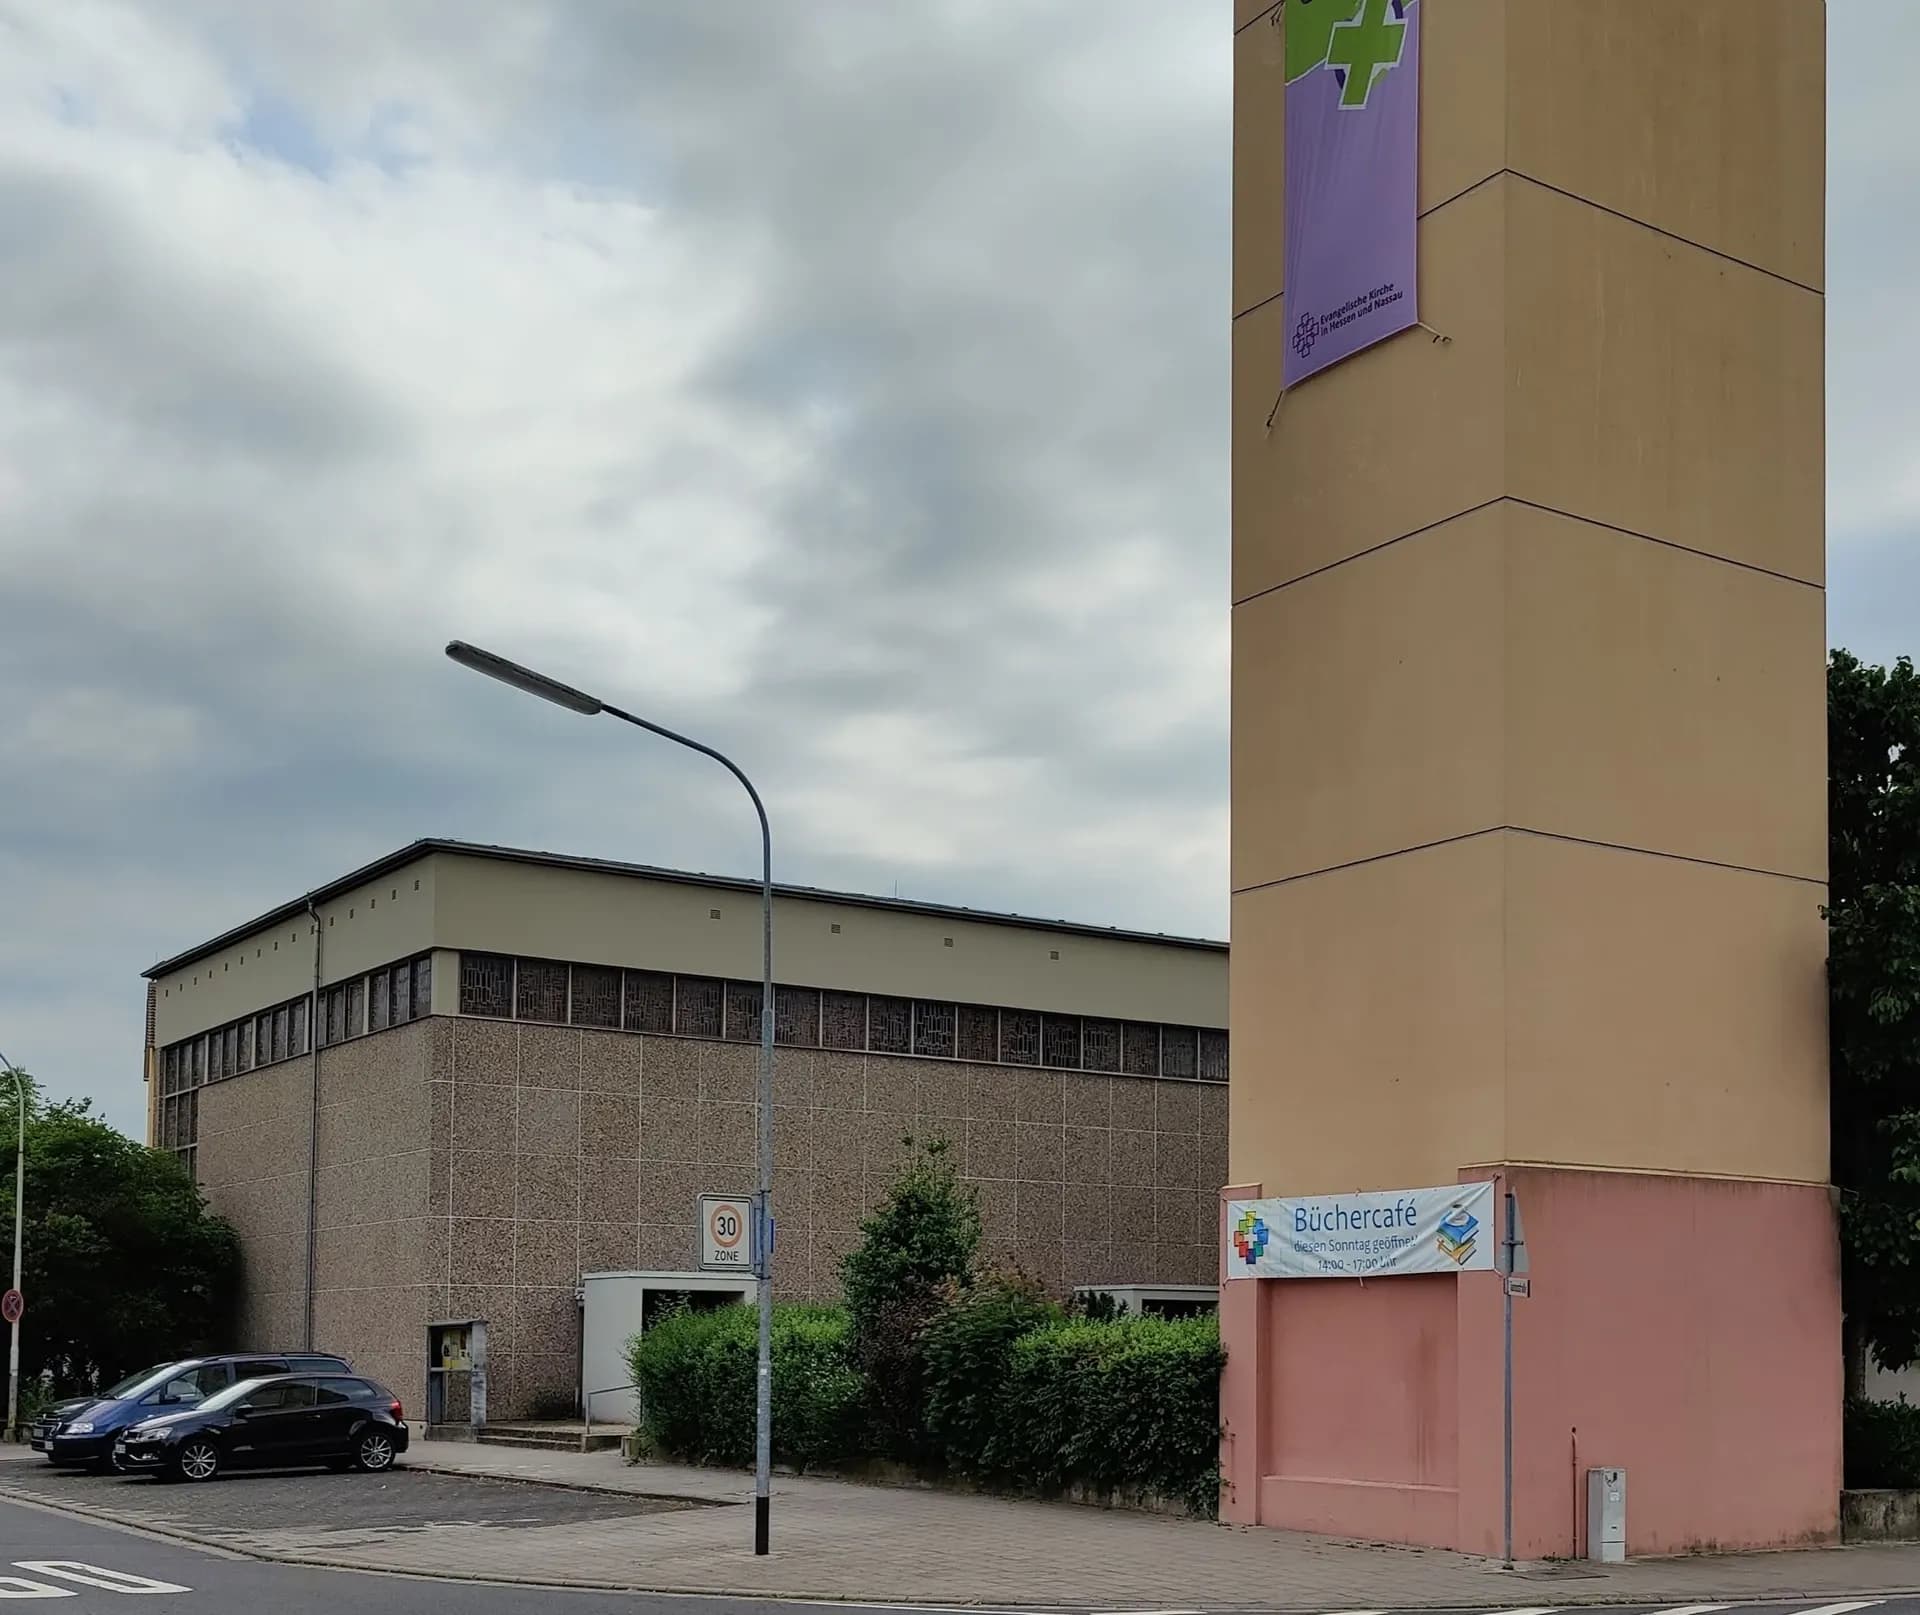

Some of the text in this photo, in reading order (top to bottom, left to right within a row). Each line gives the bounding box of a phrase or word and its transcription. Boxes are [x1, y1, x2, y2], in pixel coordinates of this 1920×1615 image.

[1320, 283, 1394, 325] Evangelische Kirche
[1320, 291, 1403, 336] in Hessen und Nassau
[1295, 1198, 1417, 1232] Büchercafé
[717, 1216, 736, 1236] 30
[714, 1250, 740, 1262] ZONE
[1294, 1240, 1327, 1253] diesen
[1329, 1239, 1370, 1254] Sonntag
[1318, 1259, 1344, 1272] 14:00
[1352, 1258, 1378, 1272] 17:00
